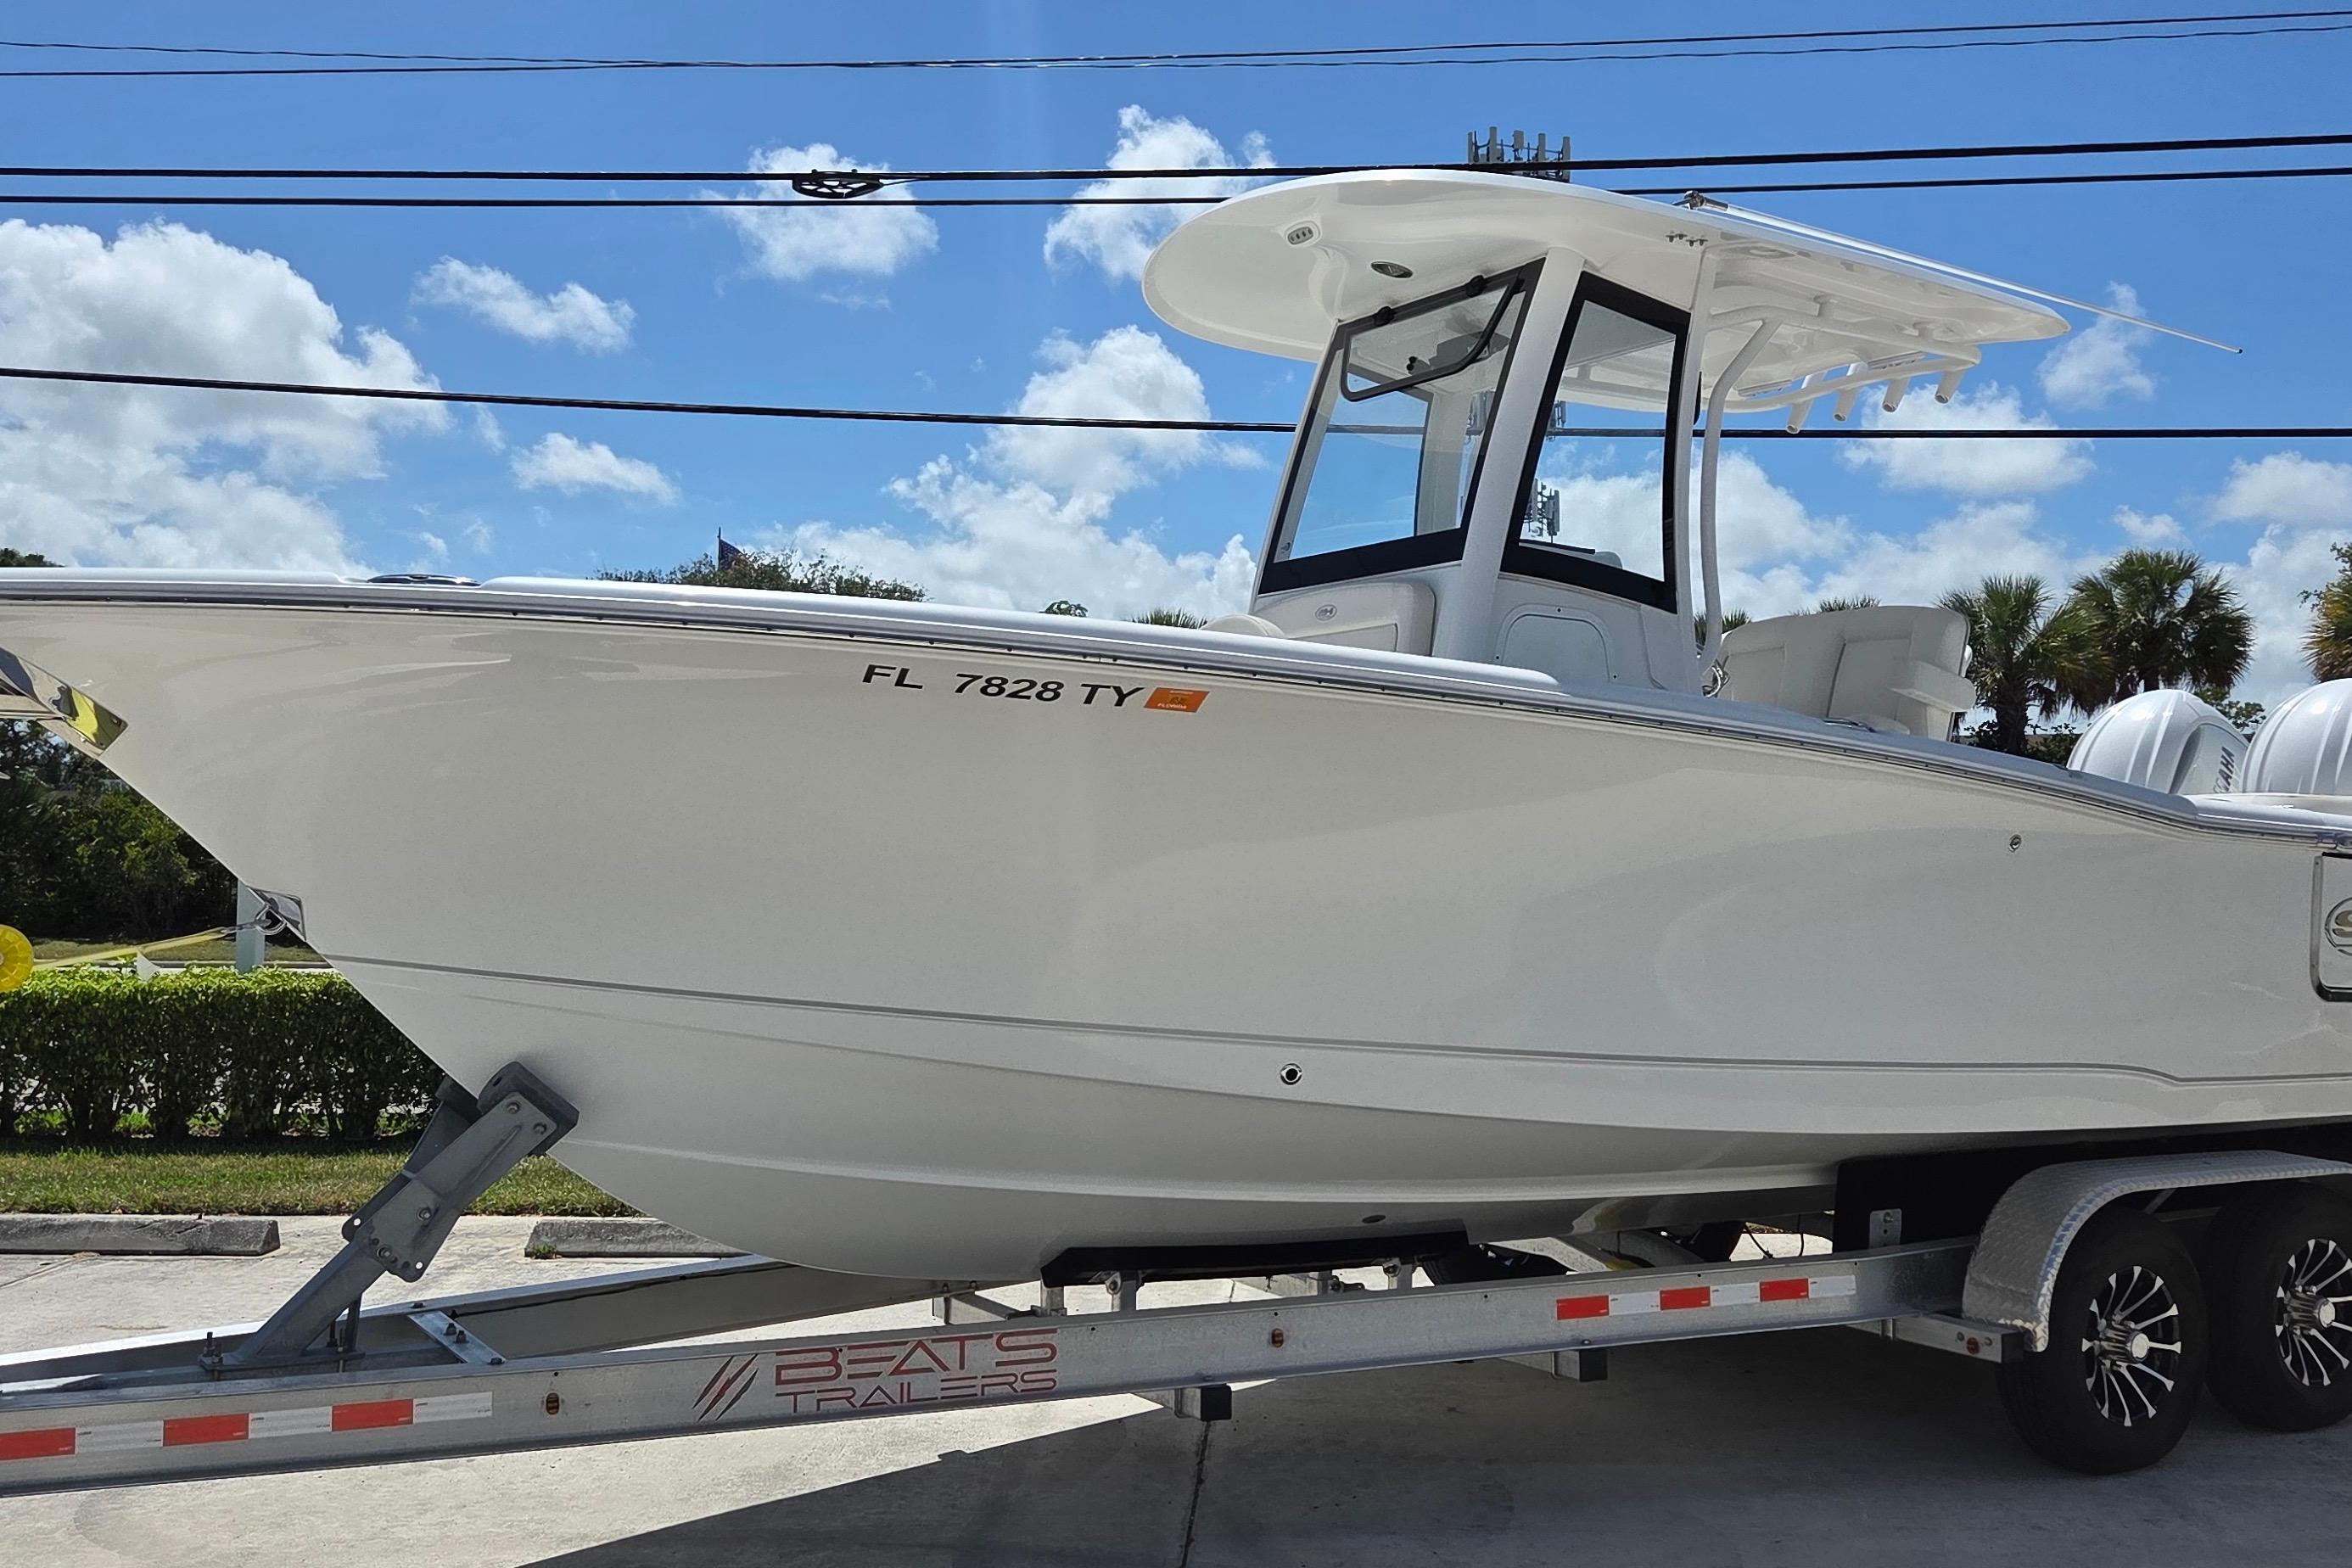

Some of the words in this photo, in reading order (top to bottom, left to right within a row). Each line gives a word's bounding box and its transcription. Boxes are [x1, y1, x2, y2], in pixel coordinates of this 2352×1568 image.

[862, 664, 924, 690] FL
[955, 673, 1065, 702] 7828
[1081, 684, 1145, 707] TY
[776, 1328, 1057, 1386] BEATS
[776, 1369, 1057, 1413] TRAILERS
